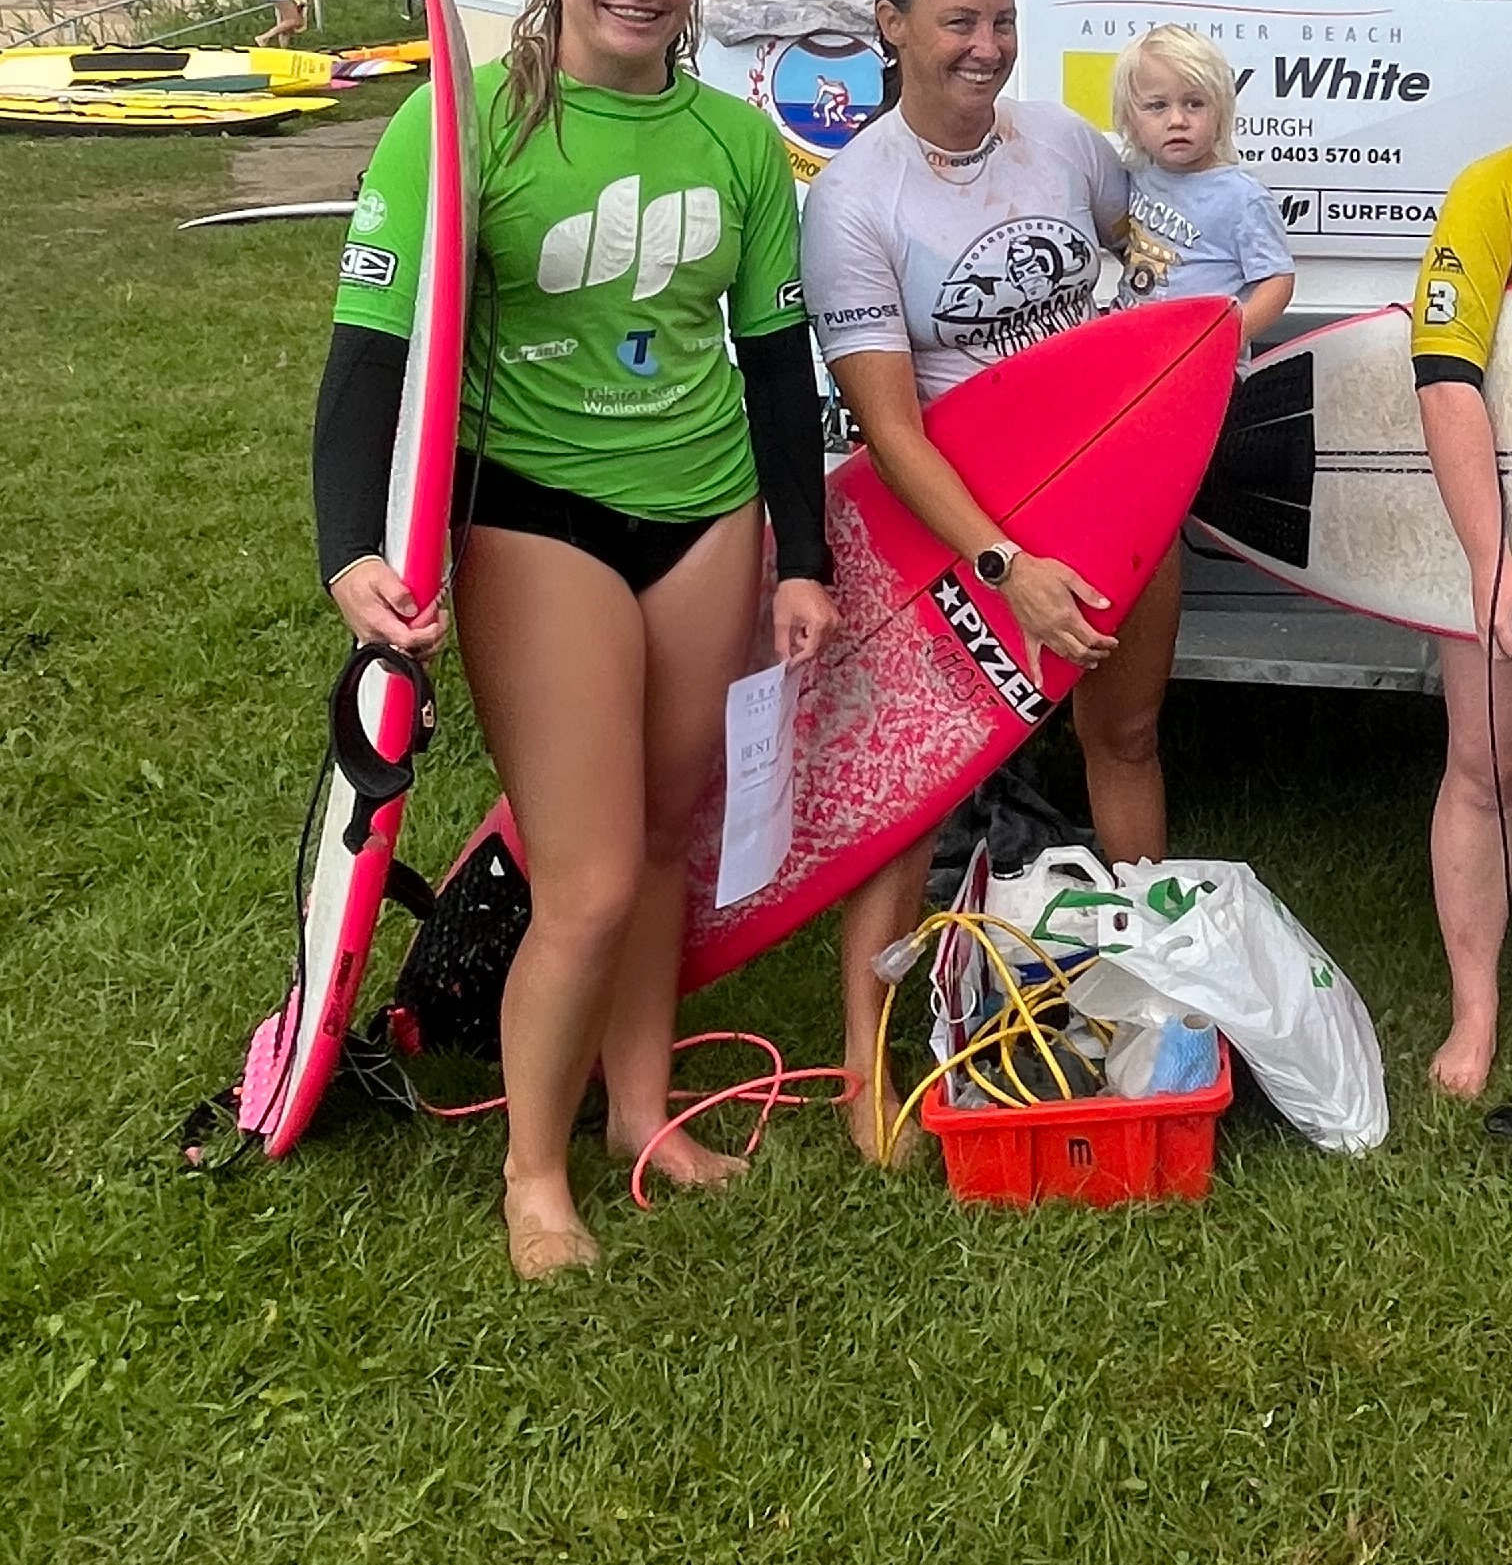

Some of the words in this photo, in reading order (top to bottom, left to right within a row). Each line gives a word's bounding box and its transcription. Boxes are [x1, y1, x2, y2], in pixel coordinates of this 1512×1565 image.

[1301, 25, 1402, 44] BEACH
[1275, 56, 1430, 103] White
[1271, 146, 1319, 163] 0403
[1325, 148, 1361, 164] 570
[1367, 149, 1402, 164] 041
[1149, 201, 1201, 250] CITY
[1327, 203, 1438, 222] SURFBOA
[823, 303, 900, 326] PURPOSE
[1425, 279, 1459, 325] 3
[950, 601, 1044, 724] PYZEL
